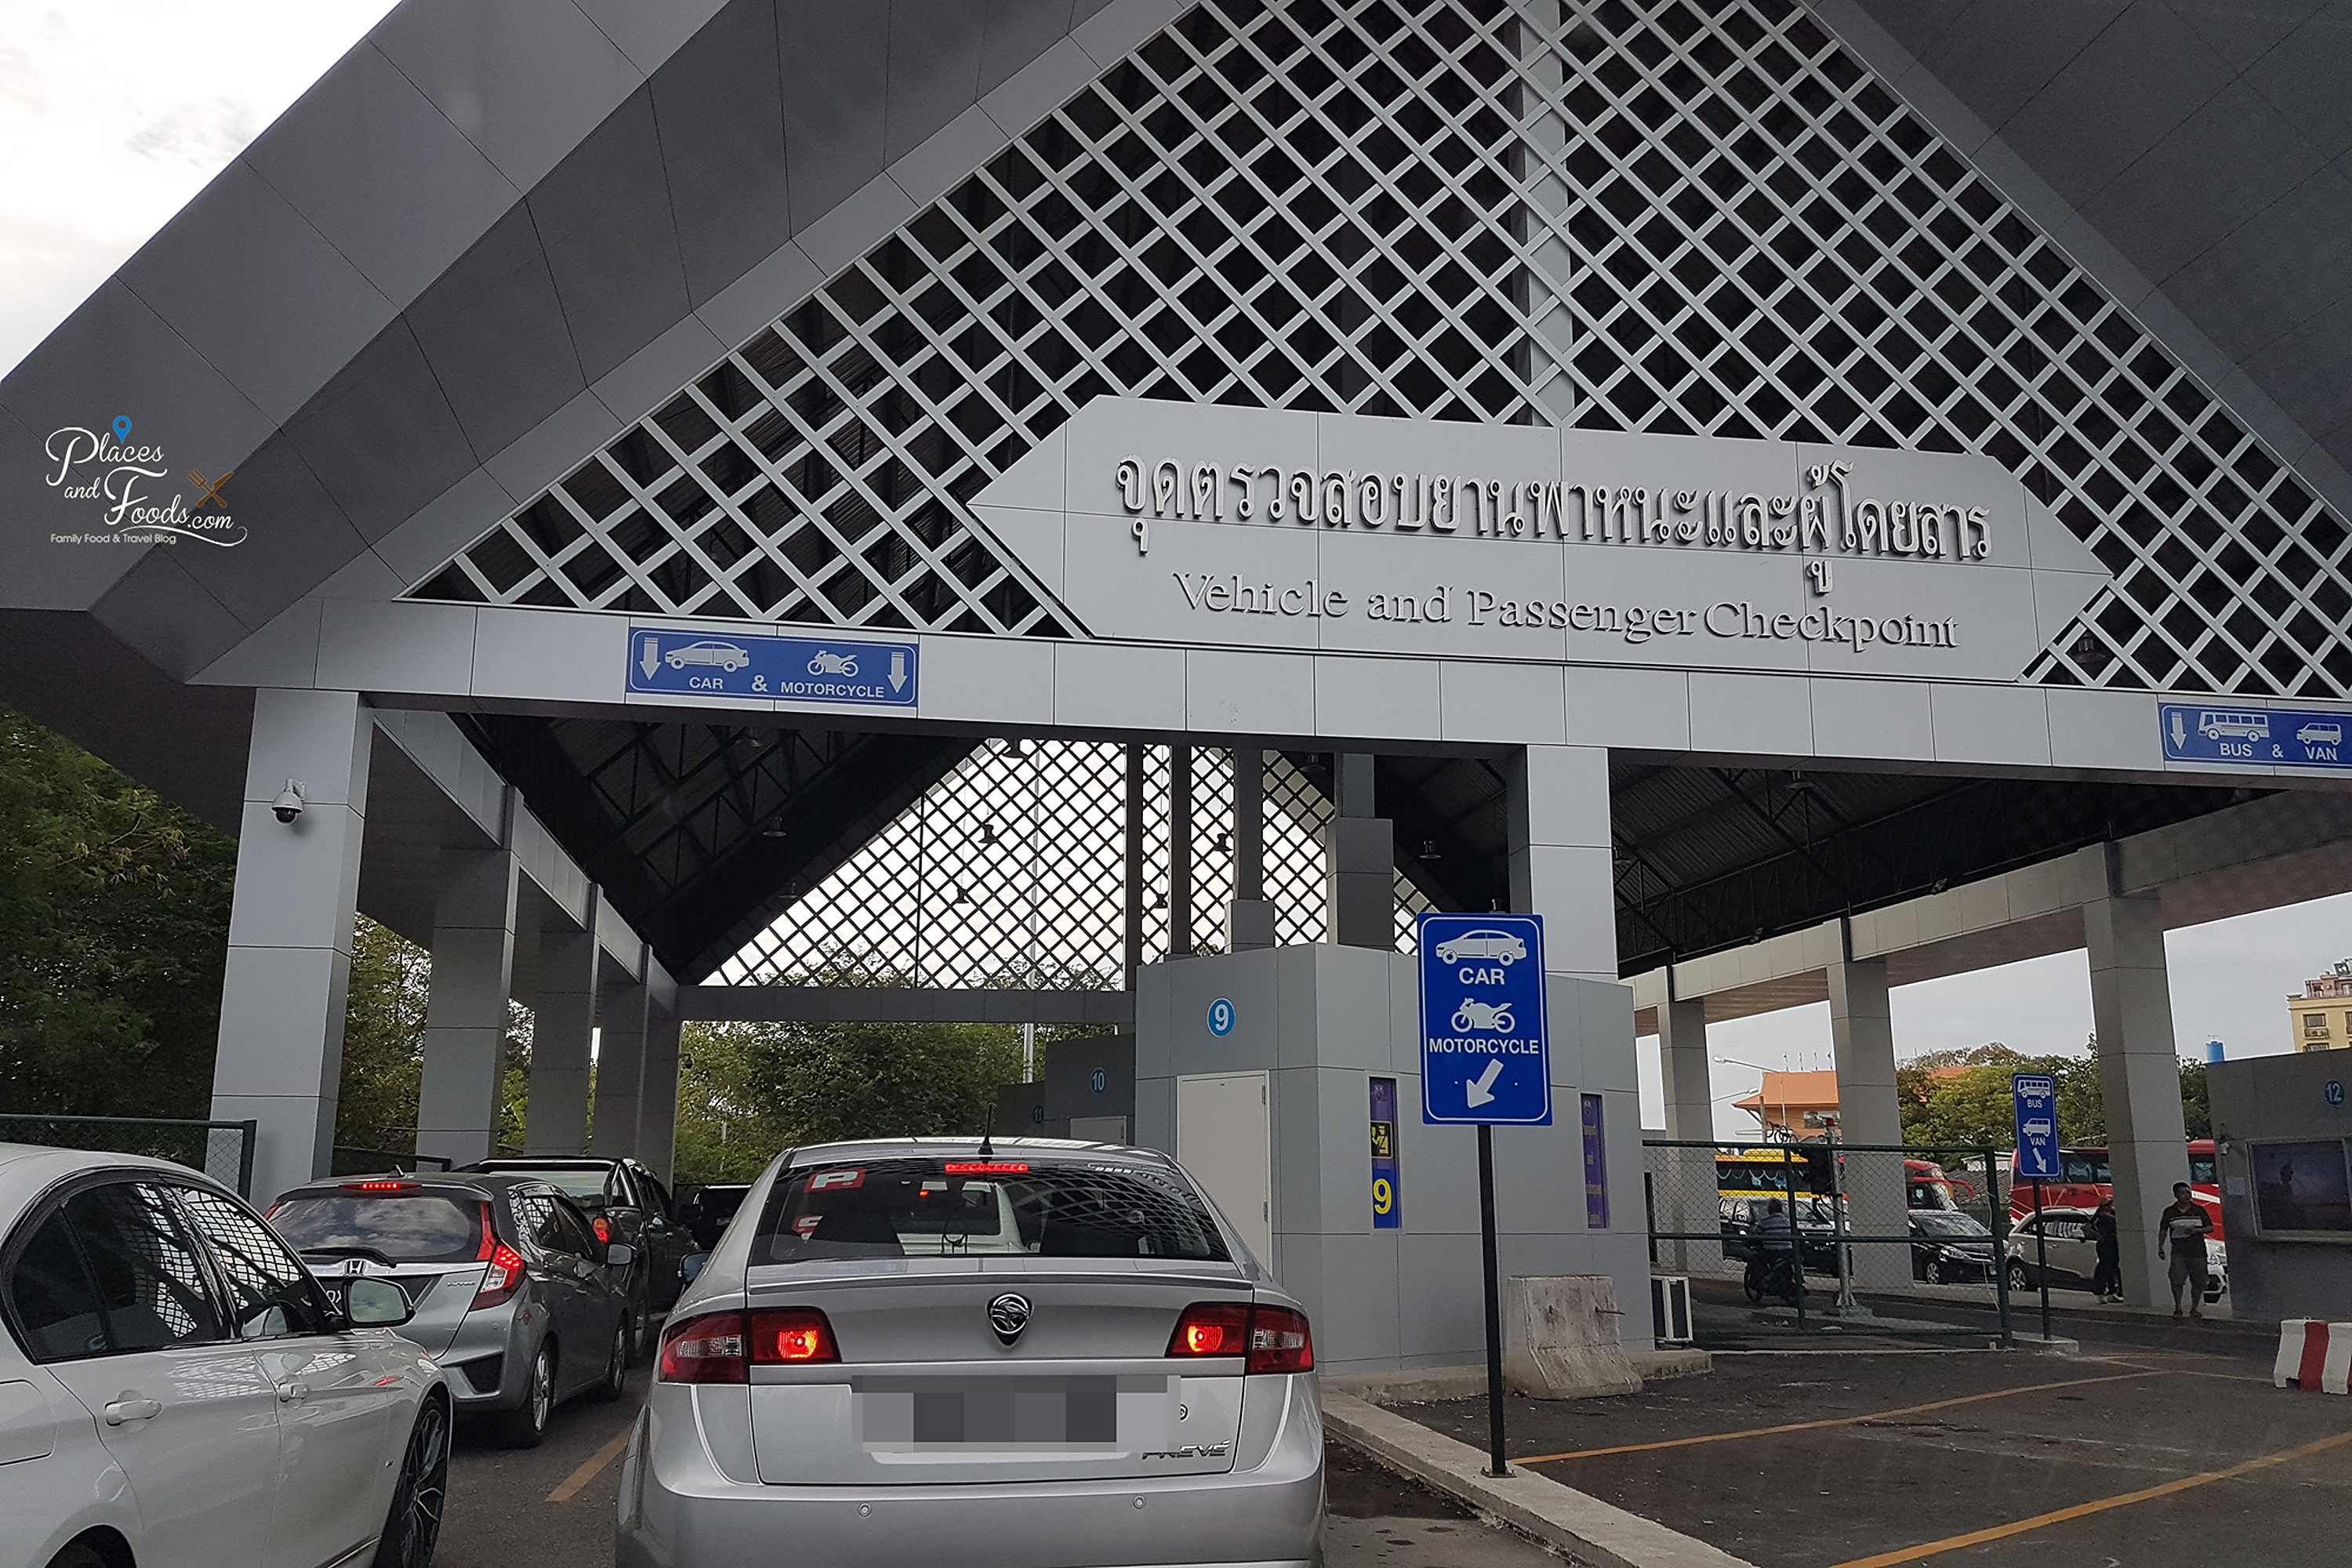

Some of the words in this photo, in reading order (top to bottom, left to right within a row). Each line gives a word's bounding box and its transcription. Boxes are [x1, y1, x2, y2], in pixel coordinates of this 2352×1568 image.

[1173, 570, 1349, 618] Vehicle
[1367, 585, 1454, 623] and
[688, 676, 724, 690] CAR
[751, 675, 768, 692] &
[780, 681, 884, 698] MOTORCYCLE
[2220, 743, 2252, 757] BUS
[2271, 744, 2285, 758] &
[2304, 746, 2338, 760] VAN
[1458, 967, 1505, 985] CAR
[1214, 1004, 1229, 1031] 9
[1429, 1038, 1539, 1054] MOTORCYCLE
[1093, 1071, 1105, 1091] 10
[2326, 1083, 2343, 1102] 12
[2027, 1099, 2043, 1108] BUS
[2030, 1137, 2046, 1146] VAN
[811, 1171, 858, 1189] P
[1373, 1178, 1392, 1214] 9
